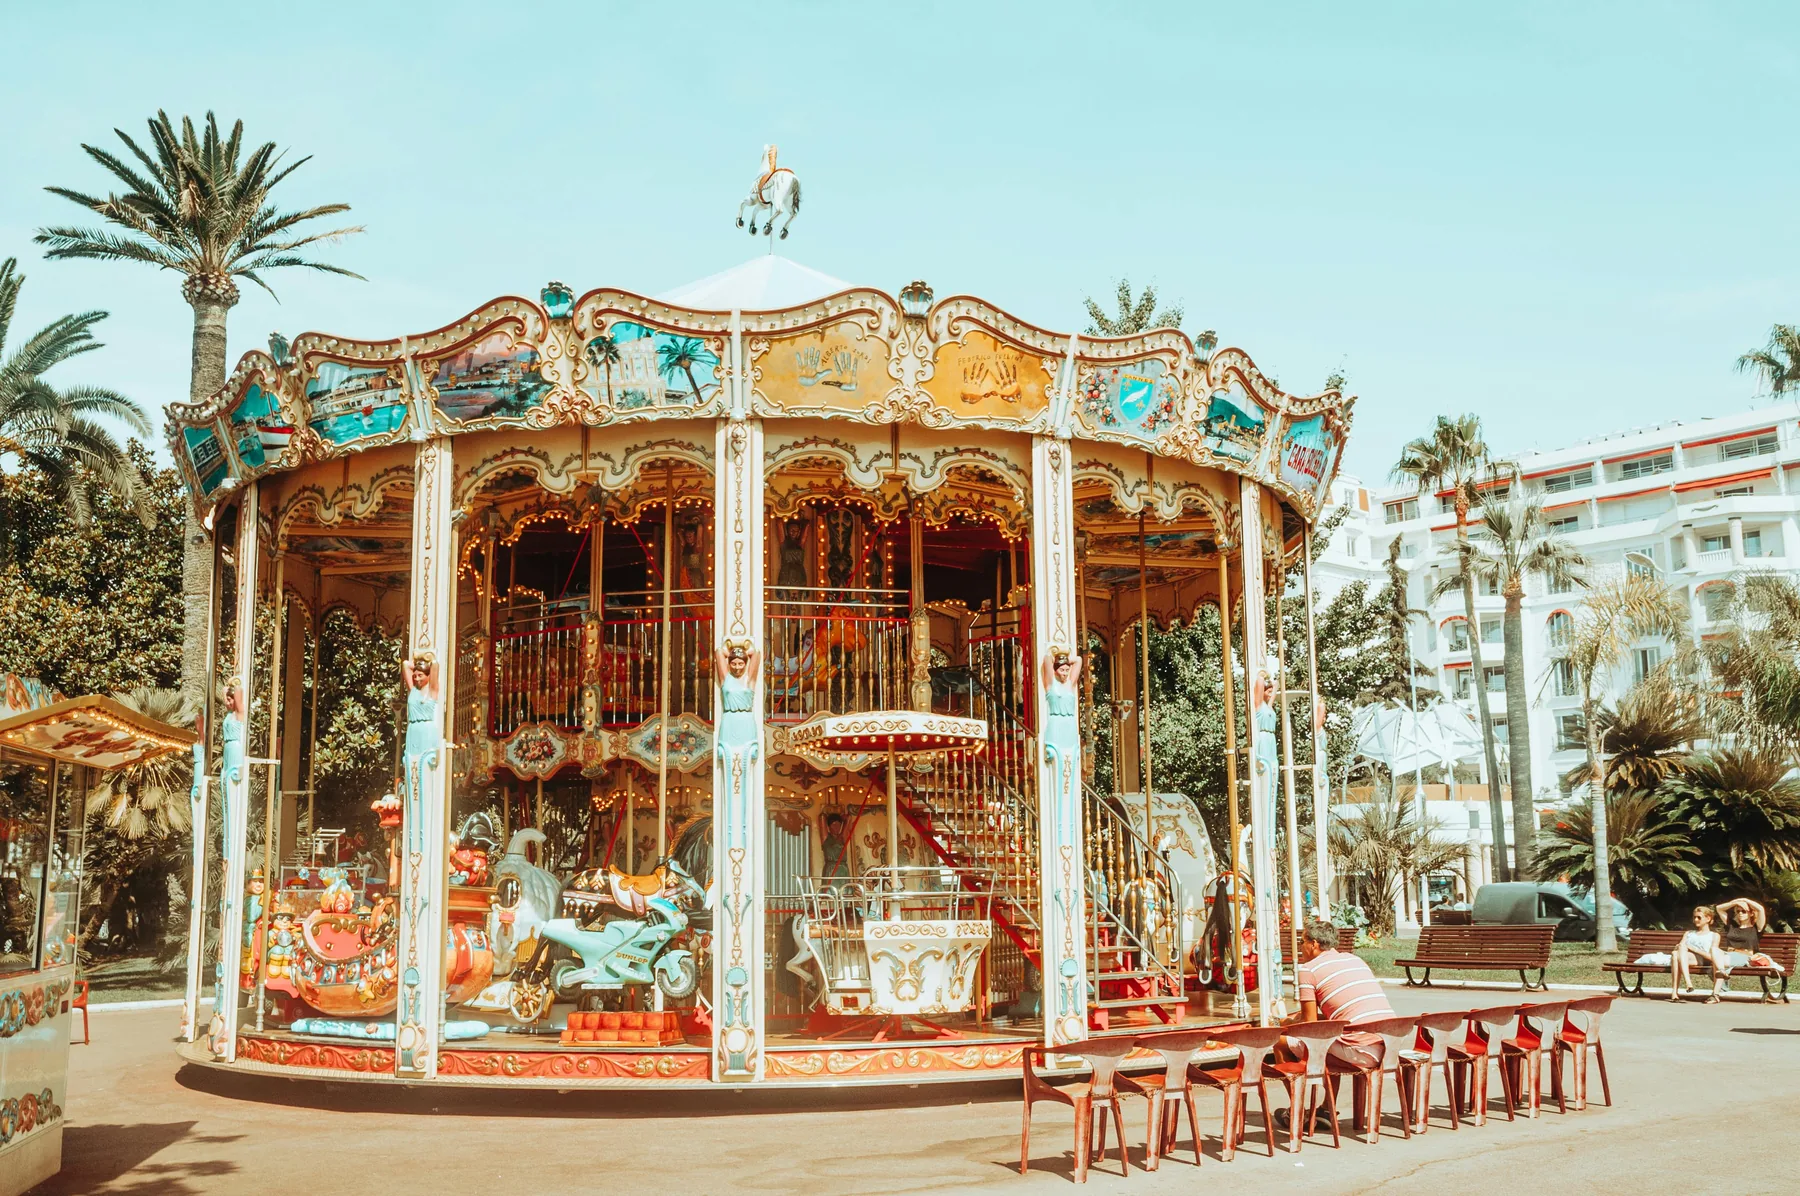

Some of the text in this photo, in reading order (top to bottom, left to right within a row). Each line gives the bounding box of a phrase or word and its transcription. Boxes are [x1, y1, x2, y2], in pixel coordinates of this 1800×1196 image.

[821, 344, 848, 366] ALBERTO
[958, 354, 991, 366] FEDERICO
[1124, 374, 1153, 384] CANNES
[616, 952, 649, 964] DUNLOP
